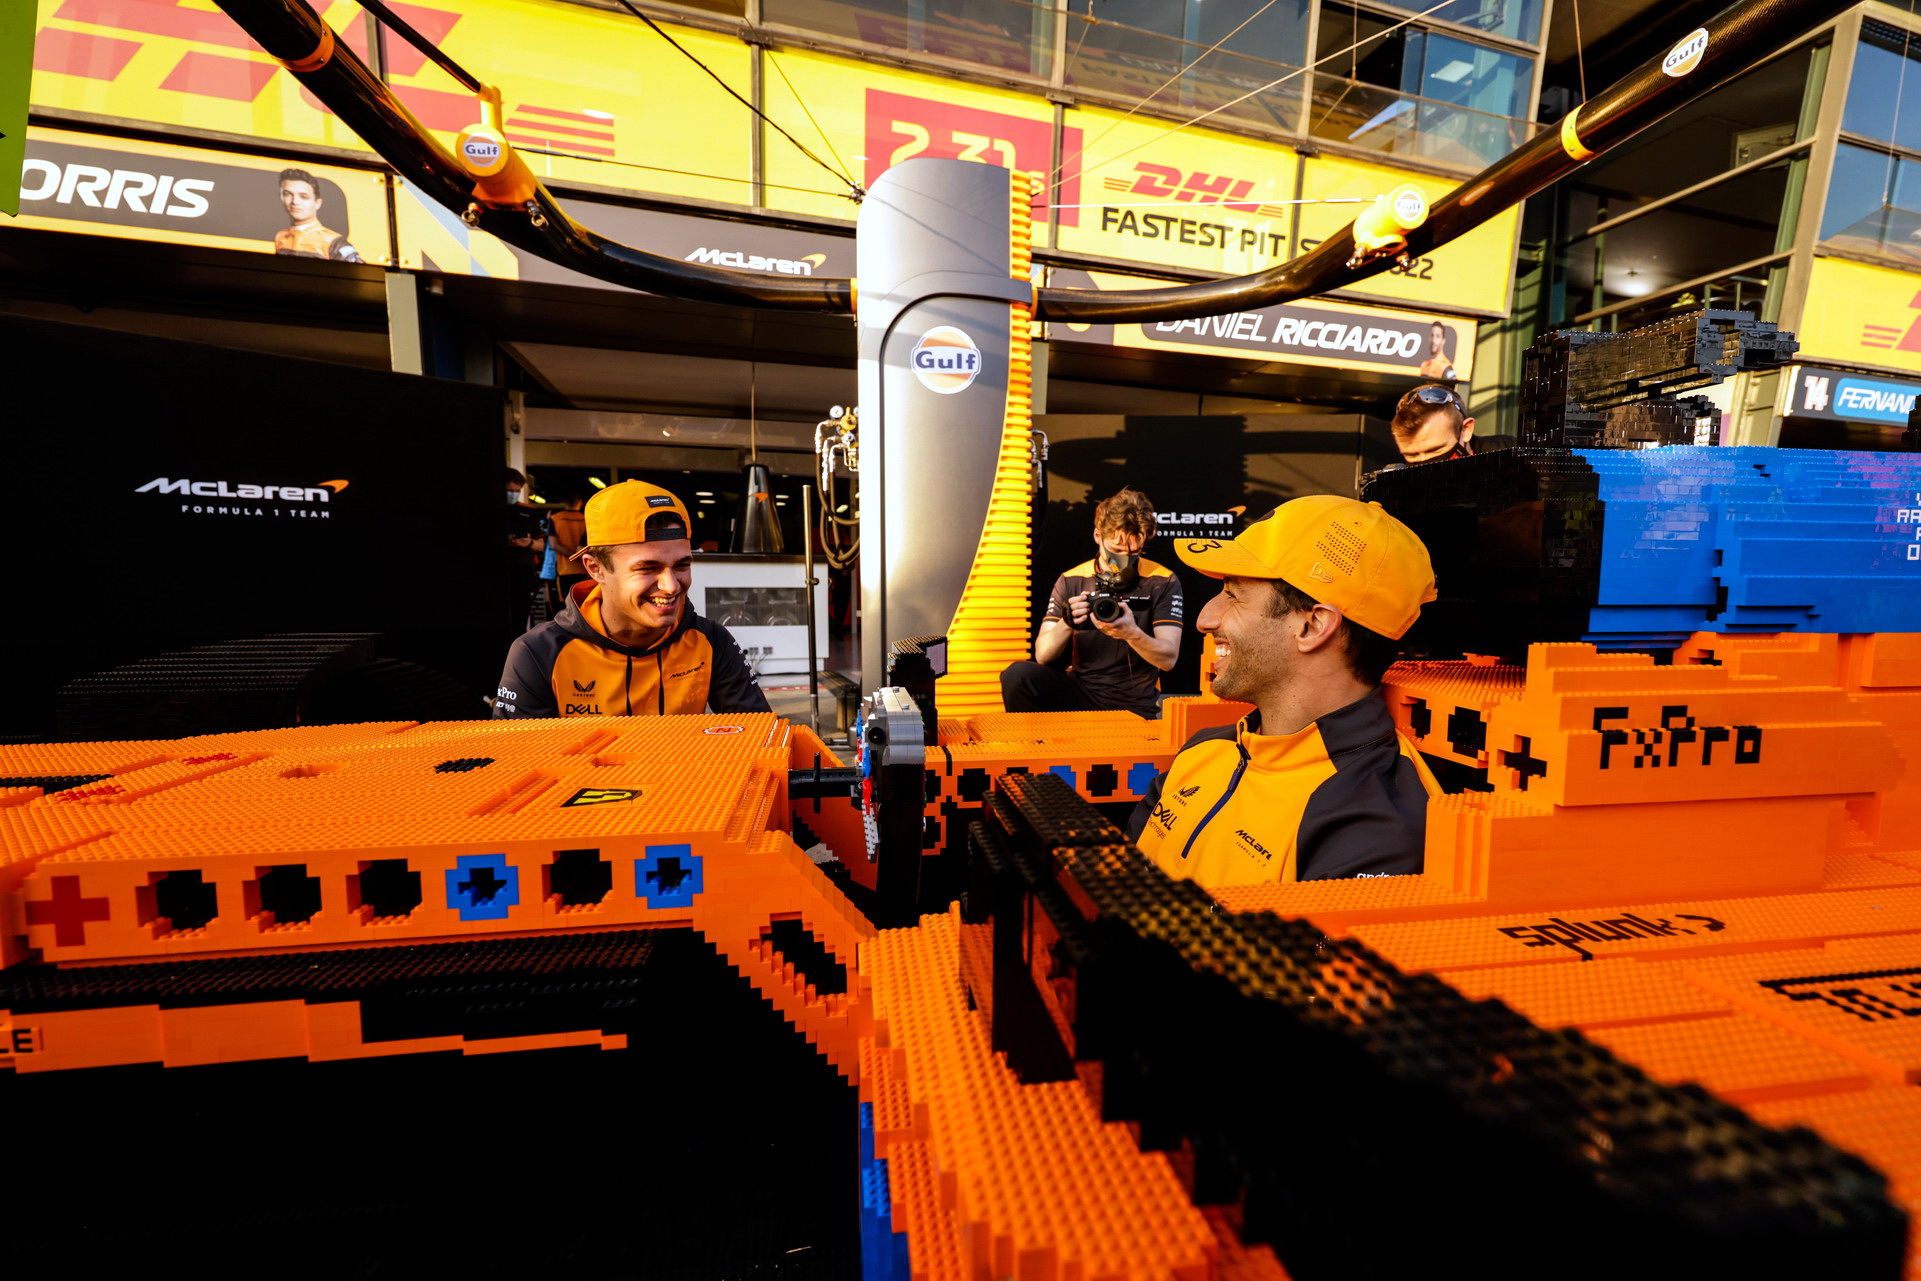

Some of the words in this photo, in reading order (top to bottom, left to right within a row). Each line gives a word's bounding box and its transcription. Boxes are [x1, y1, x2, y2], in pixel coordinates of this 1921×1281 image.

[1666, 36, 1704, 68] Gulf
[465, 144, 498, 155] Gulf
[1130, 161, 1262, 214] DHL
[1102, 206, 1234, 250] FASTEST
[1240, 229, 1287, 258] PIT
[685, 247, 812, 276] McLaren
[1271, 316, 1423, 359] RICCIARDO
[915, 350, 977, 370] Gulf
[1804, 374, 1830, 412] 14
[134, 477, 330, 503] McLaren
[181, 504, 264, 517] FORMULA
[273, 508, 280, 517] 1
[289, 509, 331, 519] TEAM
[565, 703, 603, 715] DELL
[1592, 704, 1763, 770] FxPro
[1152, 801, 1178, 831] DELL
